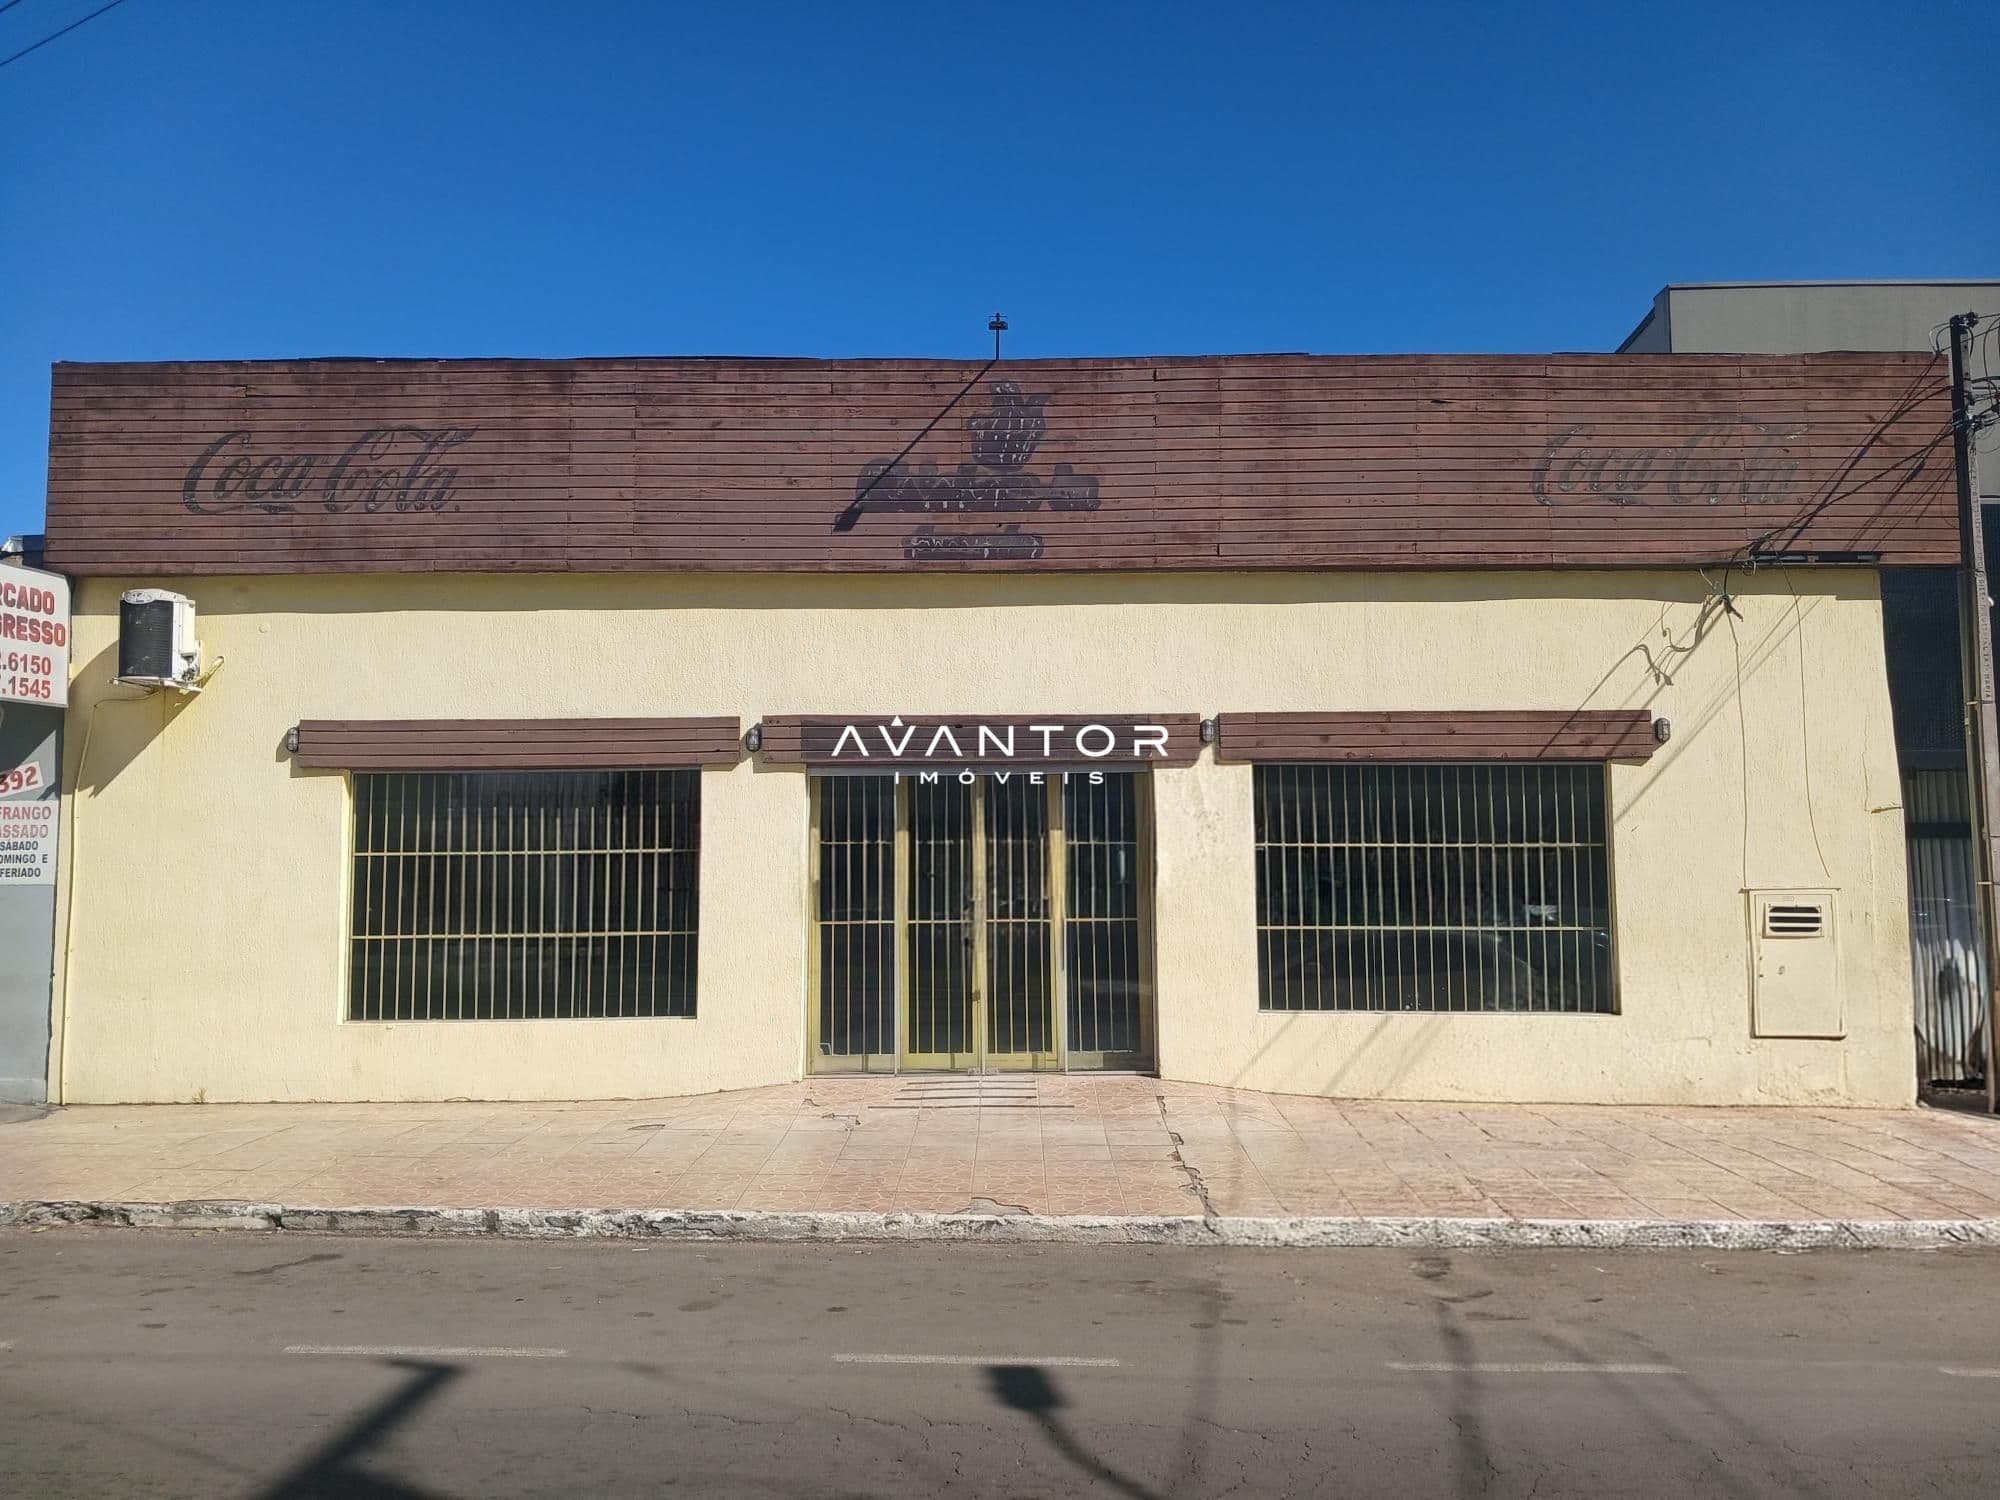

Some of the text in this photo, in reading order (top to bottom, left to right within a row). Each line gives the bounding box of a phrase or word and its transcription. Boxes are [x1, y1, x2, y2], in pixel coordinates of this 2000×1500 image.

[0, 582, 55, 616] CADO
[0, 612, 66, 647] RESSO
[0, 652, 51, 675] .6150
[0, 676, 51, 699] .1545
[0, 806, 52, 820] RANGO
[0, 824, 49, 838] SSADO
[42, 854, 48, 864] E
